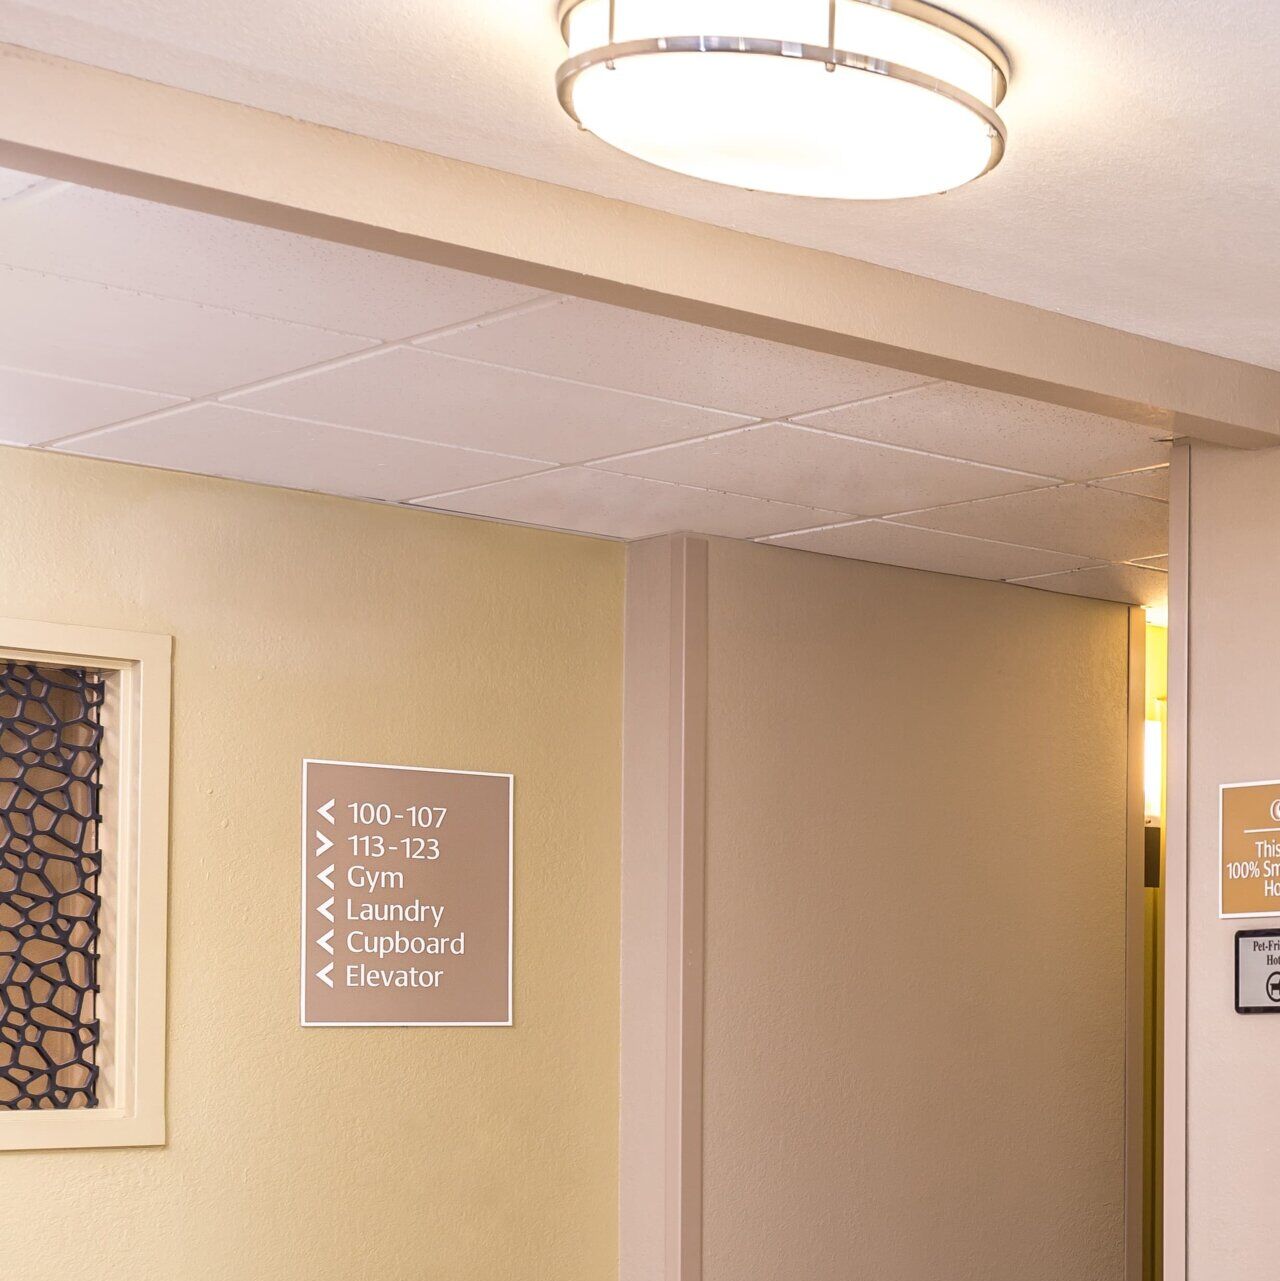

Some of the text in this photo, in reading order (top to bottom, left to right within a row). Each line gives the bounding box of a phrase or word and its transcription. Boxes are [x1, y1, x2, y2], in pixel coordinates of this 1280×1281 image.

[346, 865, 404, 893] Gym
[1226, 861, 1260, 879] 100%
[346, 898, 445, 928] Laundry
[346, 930, 465, 959] Cupboard
[345, 963, 444, 988] Elevator
